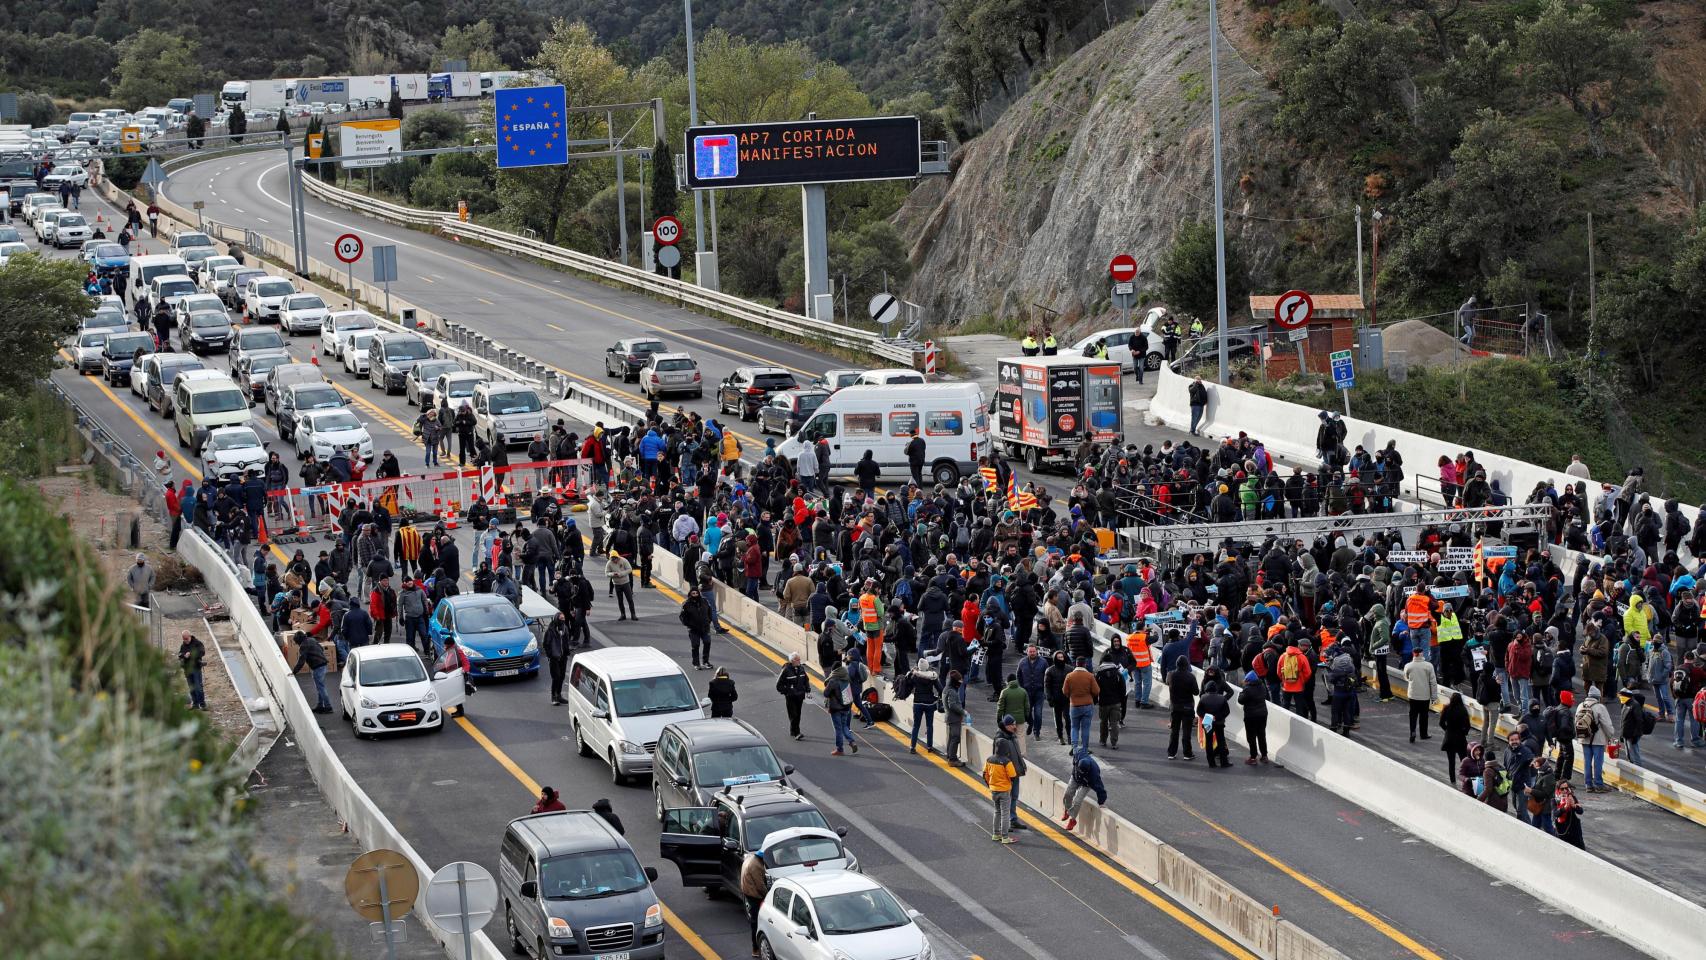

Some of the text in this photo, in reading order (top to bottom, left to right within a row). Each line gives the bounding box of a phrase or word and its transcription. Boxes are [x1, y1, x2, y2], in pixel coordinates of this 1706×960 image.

[513, 122, 550, 131] ESPAÑA
[740, 128, 856, 145] AP7 CORTADA
[740, 143, 877, 161] MANIFESTACION
[659, 225, 678, 236] 100
